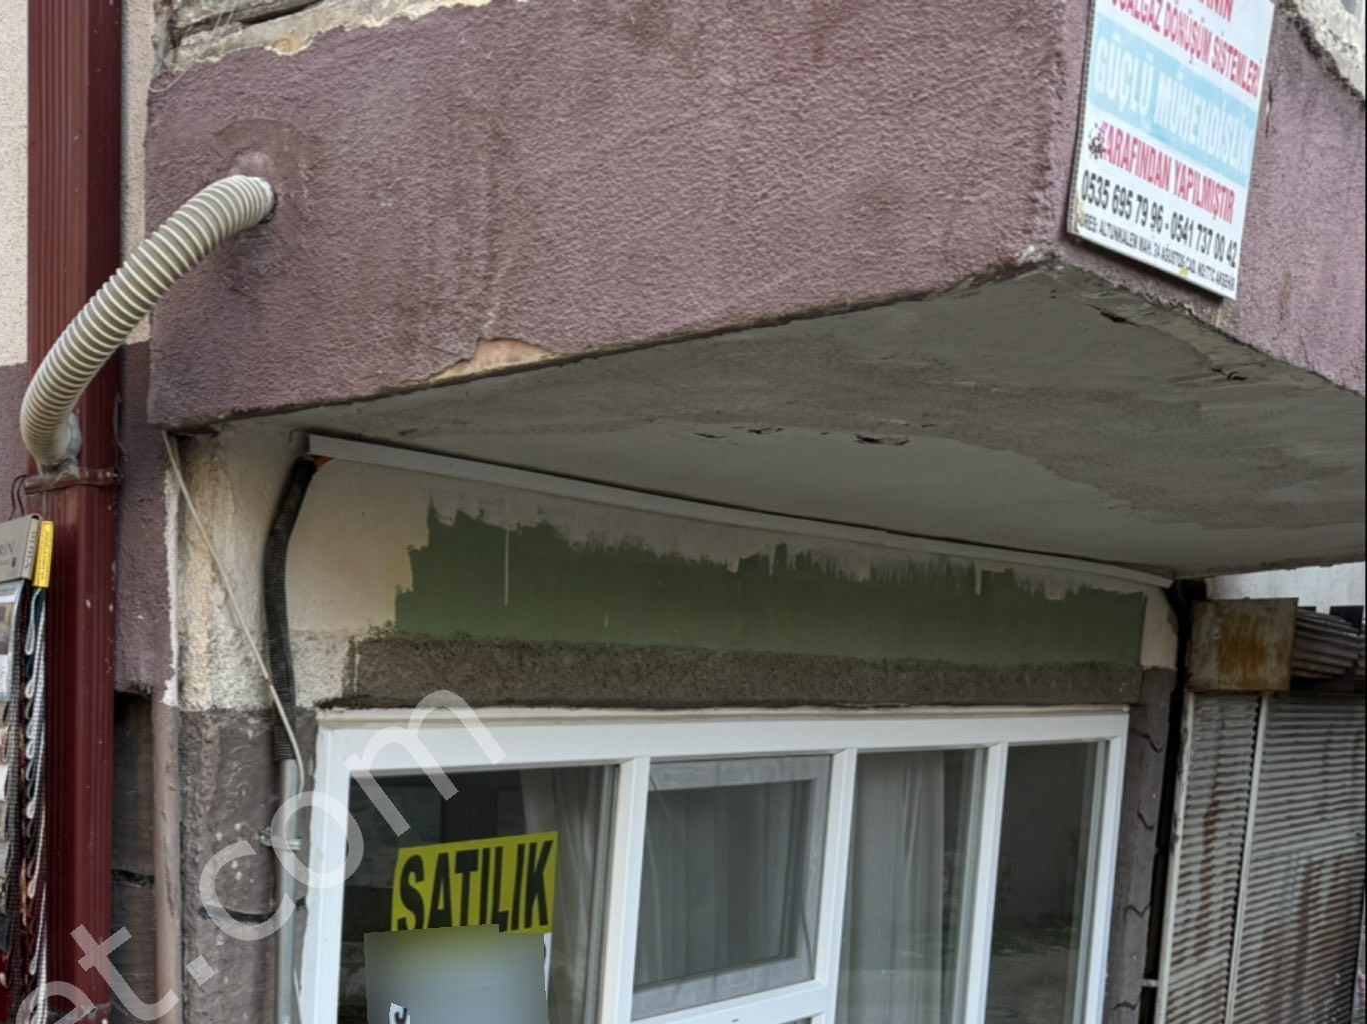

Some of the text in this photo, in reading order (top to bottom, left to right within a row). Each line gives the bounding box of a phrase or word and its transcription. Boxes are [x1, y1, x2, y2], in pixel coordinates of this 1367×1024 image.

[1094, 33, 1155, 117] GÜÇLÜ
[1081, 170, 1110, 210] 0535
[1112, 184, 1133, 220] 695
[1135, 194, 1148, 227] 79
[398, 840, 553, 932] SATILIK
